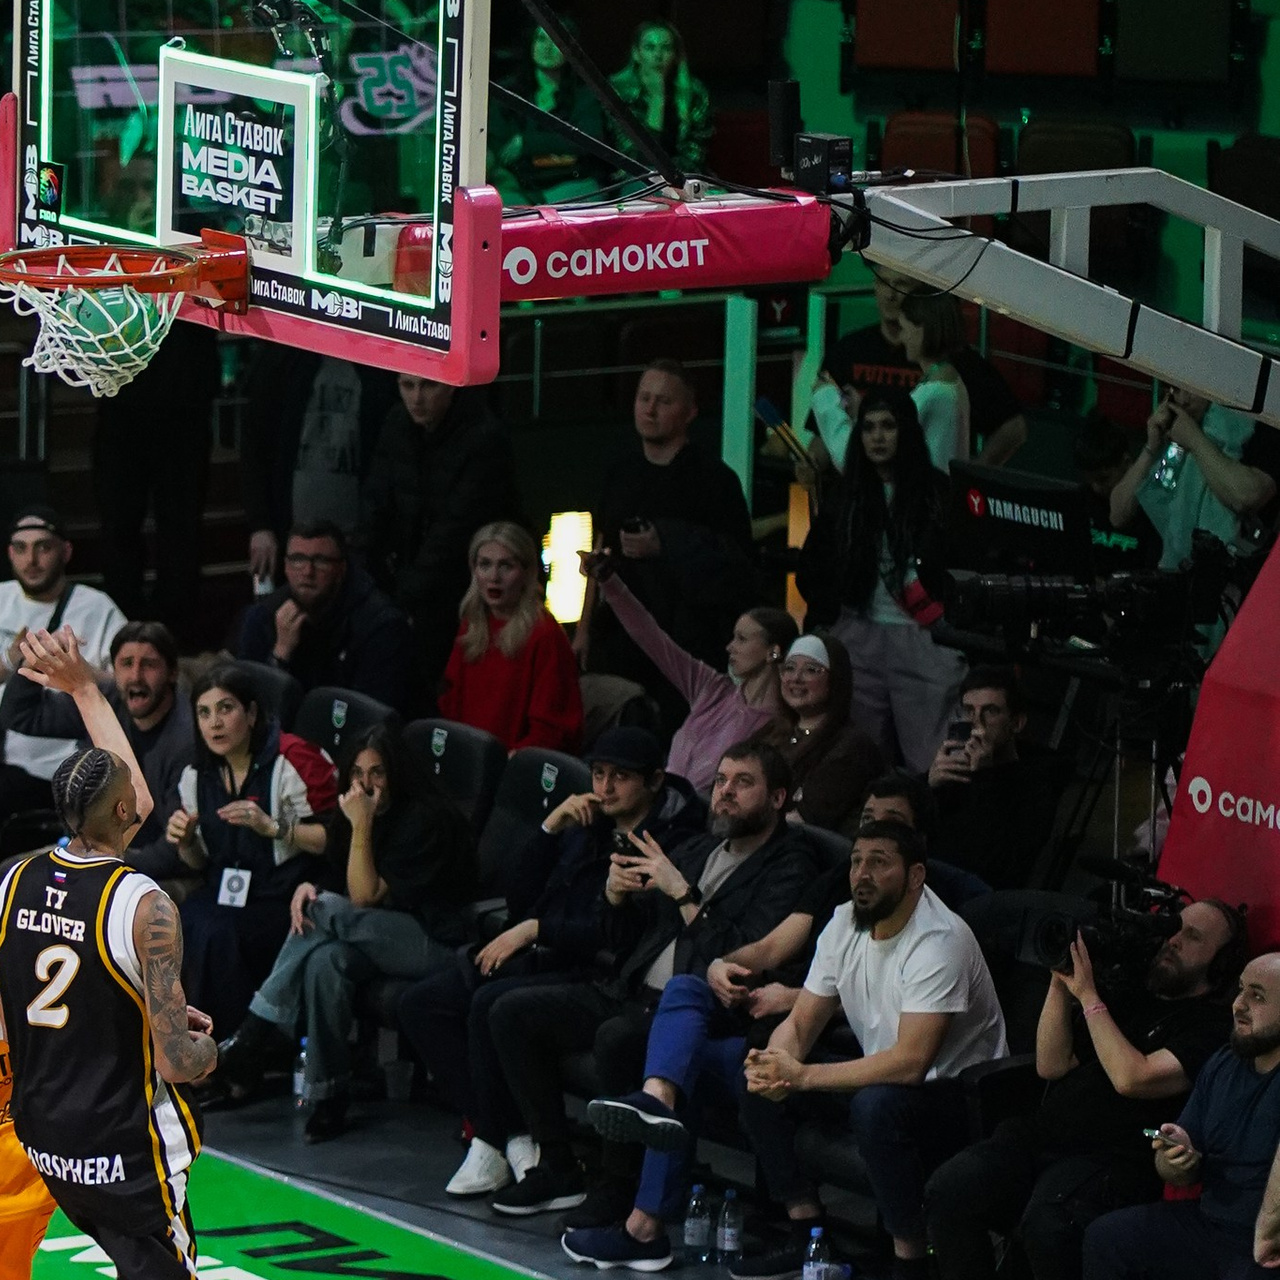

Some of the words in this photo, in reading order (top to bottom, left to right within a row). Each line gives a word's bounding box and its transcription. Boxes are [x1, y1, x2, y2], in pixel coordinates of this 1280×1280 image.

[182, 142, 282, 190] MEDIA
[181, 173, 282, 214] BASKET
[986, 496, 1065, 532] YAMAGUCHI
[45, 886, 67, 910] TY
[16, 908, 86, 942] GLOVER
[27, 944, 81, 1029] 2
